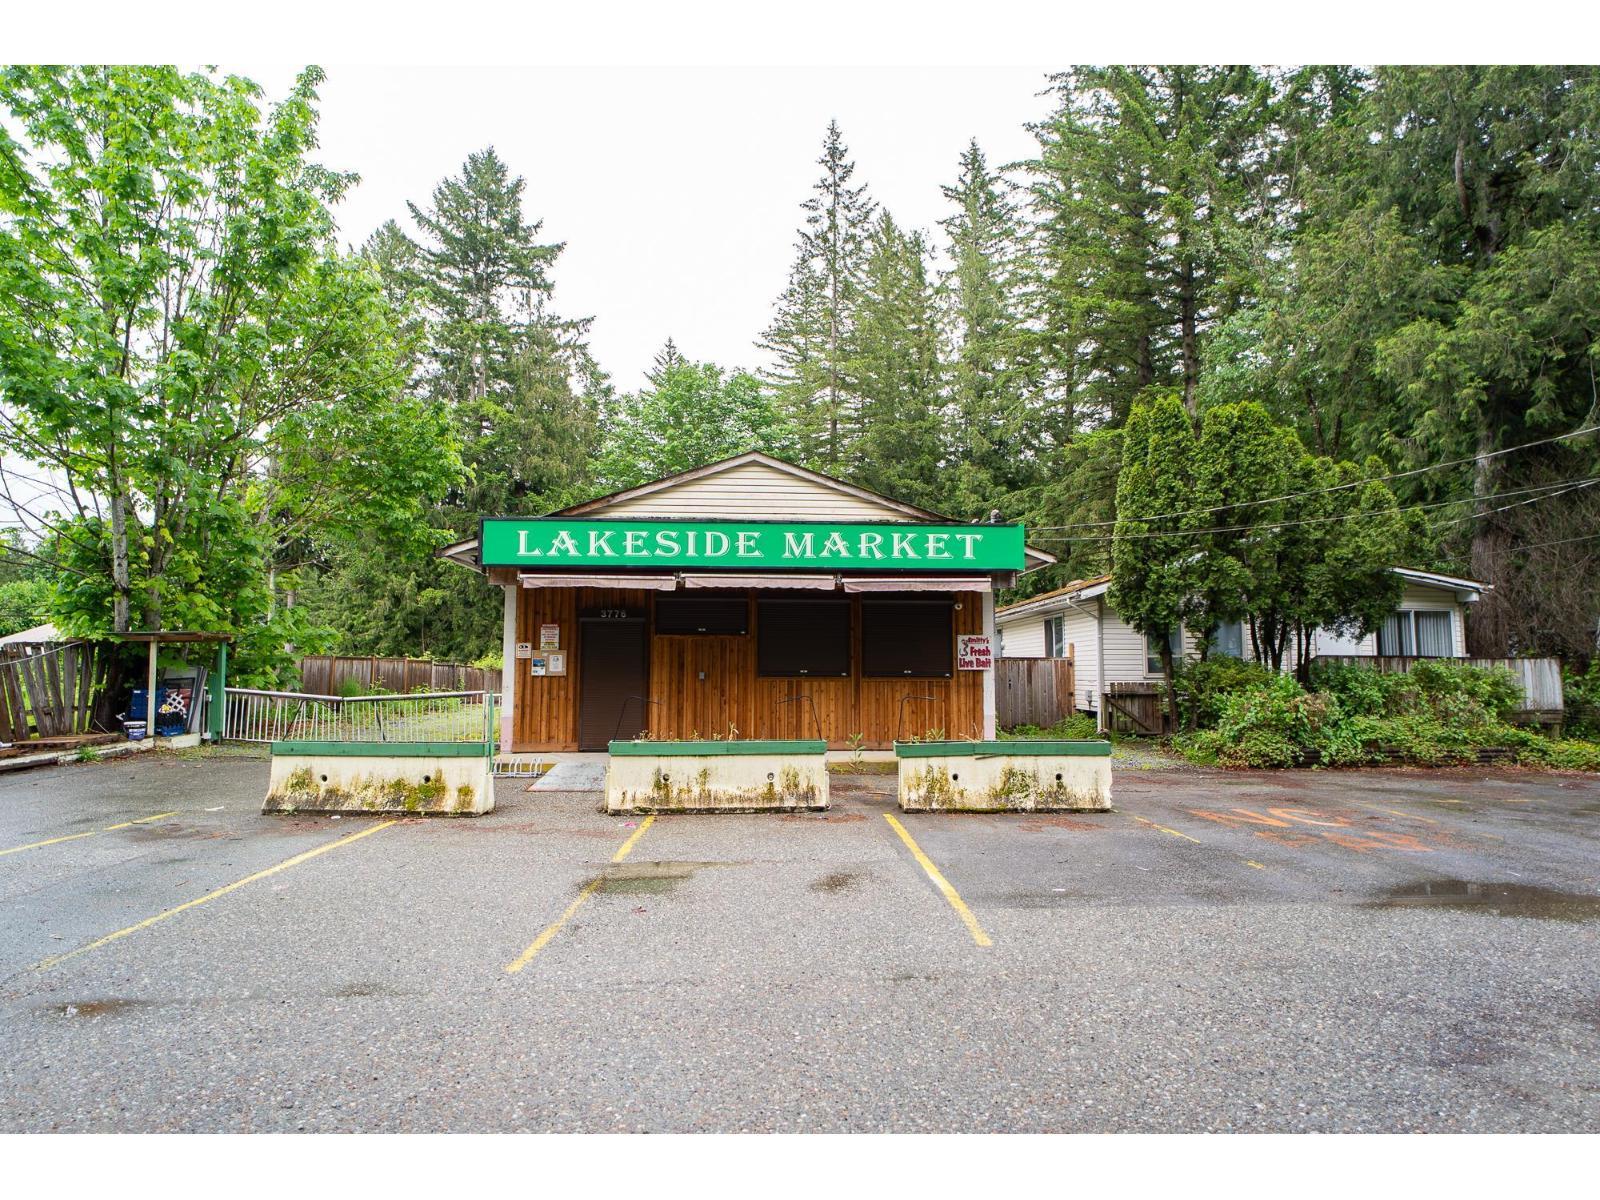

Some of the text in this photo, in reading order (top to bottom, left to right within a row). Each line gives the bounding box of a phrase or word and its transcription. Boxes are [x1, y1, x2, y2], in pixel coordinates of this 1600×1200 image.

[516, 529, 984, 560] LAKESIDE MARKET
[969, 646, 991, 657] Fresh
[959, 657, 991, 668] Live Bait
